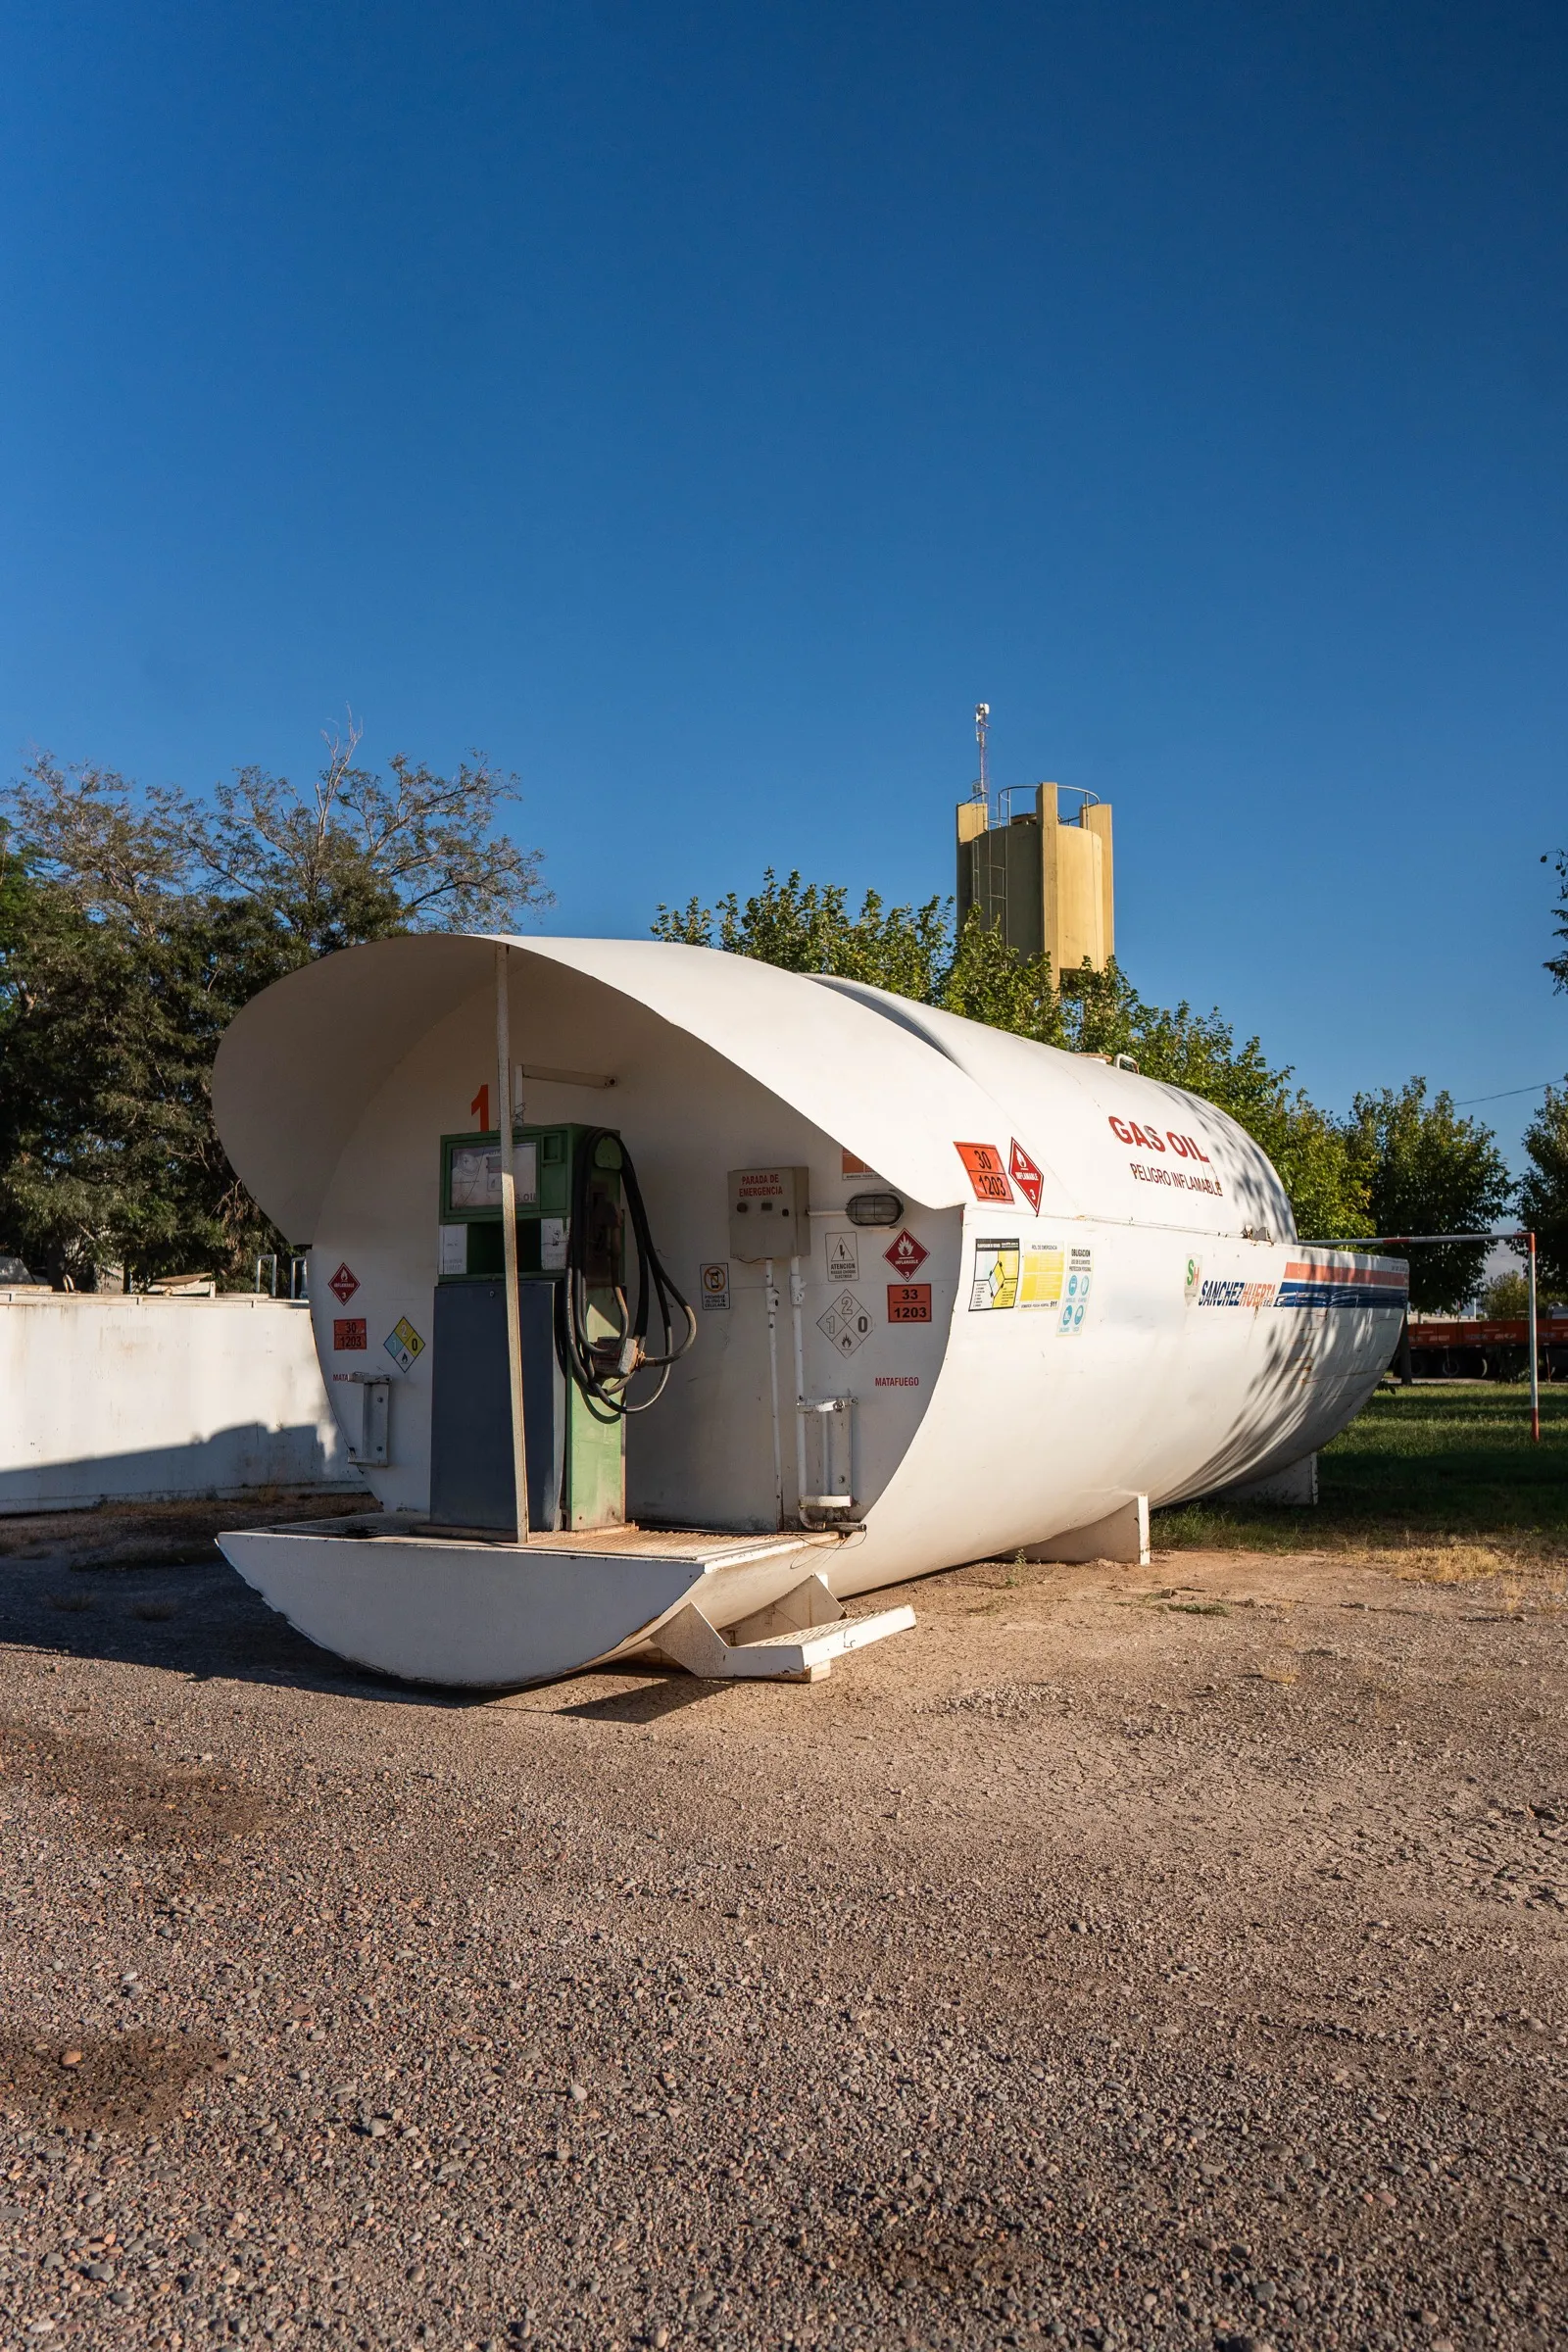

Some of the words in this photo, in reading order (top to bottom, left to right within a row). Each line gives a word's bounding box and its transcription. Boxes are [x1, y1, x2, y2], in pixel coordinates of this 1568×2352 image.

[471, 1084, 489, 1132] 1
[1108, 1116, 1165, 1152] GAS
[1166, 1132, 1210, 1162] OIL
[973, 1150, 992, 1169] 30
[742, 1175, 768, 1185] PARADA
[770, 1174, 779, 1183] DE
[979, 1176, 1005, 1196] 1203
[1130, 1163, 1172, 1186] PELIGRO
[1170, 1172, 1223, 1197] INFLAMABLE
[739, 1186, 783, 1197] EMERGENCIA
[1029, 1189, 1036, 1200] 3
[902, 1289, 918, 1299] 33
[842, 1296, 853, 1315] 2
[894, 1307, 927, 1318] 1203
[346, 1322, 356, 1333] 30
[401, 1325, 408, 1338] 2
[826, 1316, 835, 1334] 1
[858, 1316, 867, 1333] 0
[341, 1336, 362, 1348] 1203
[393, 1340, 397, 1350] 1
[413, 1338, 417, 1351] 0
[875, 1377, 919, 1386] MATAFUEGO
